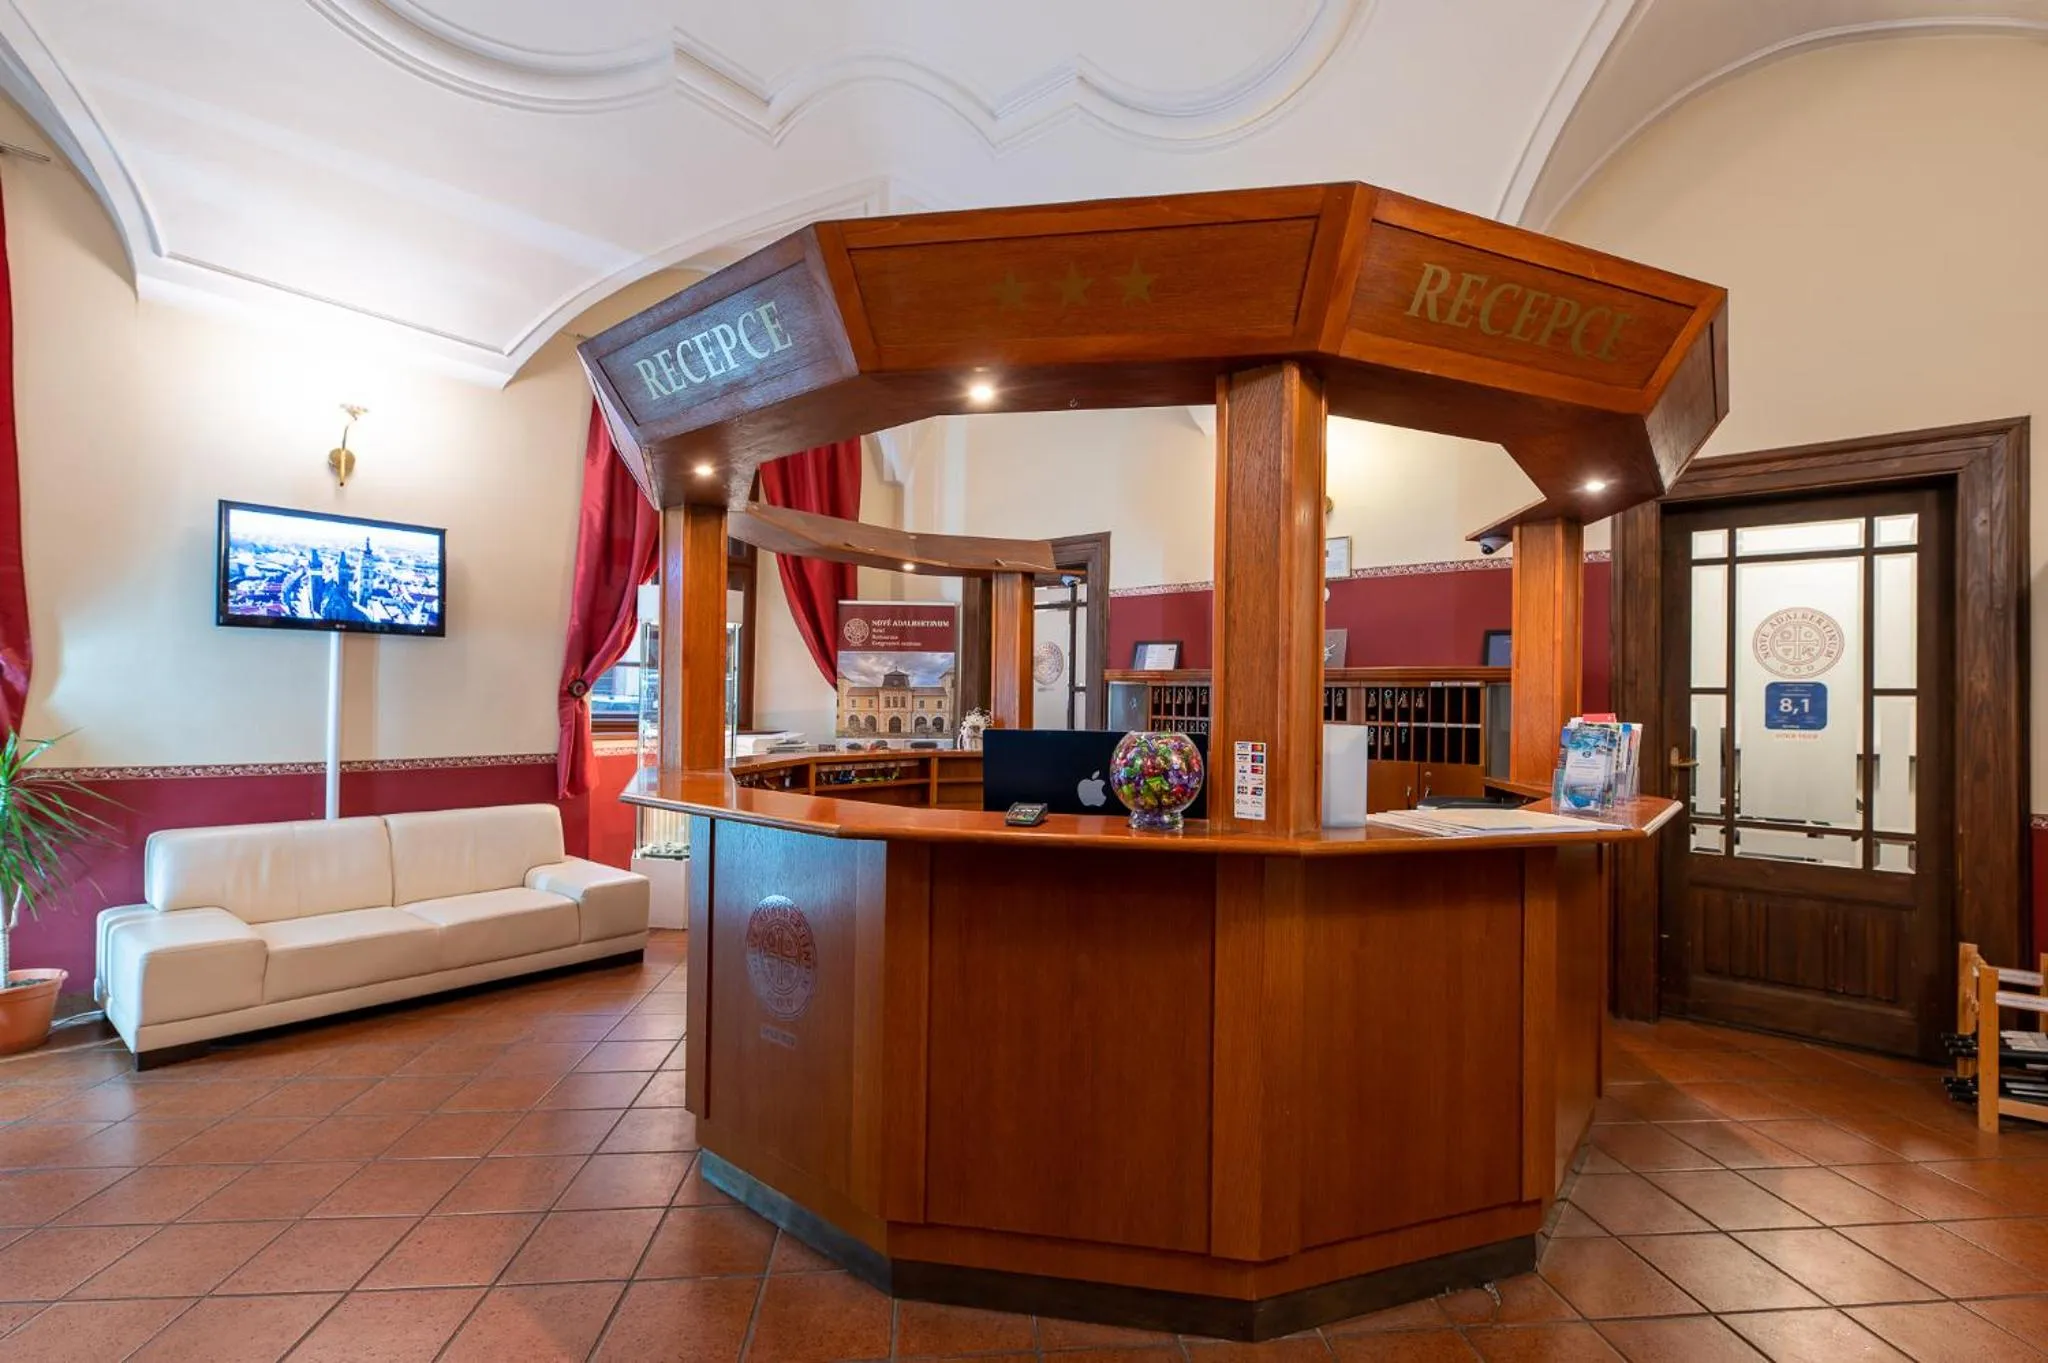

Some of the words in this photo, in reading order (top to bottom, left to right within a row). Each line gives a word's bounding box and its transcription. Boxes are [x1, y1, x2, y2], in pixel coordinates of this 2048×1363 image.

[634, 302, 793, 400] RECEPCE
[1404, 262, 1637, 362] RECEPCE
[1780, 698, 1810, 715] 8,1
